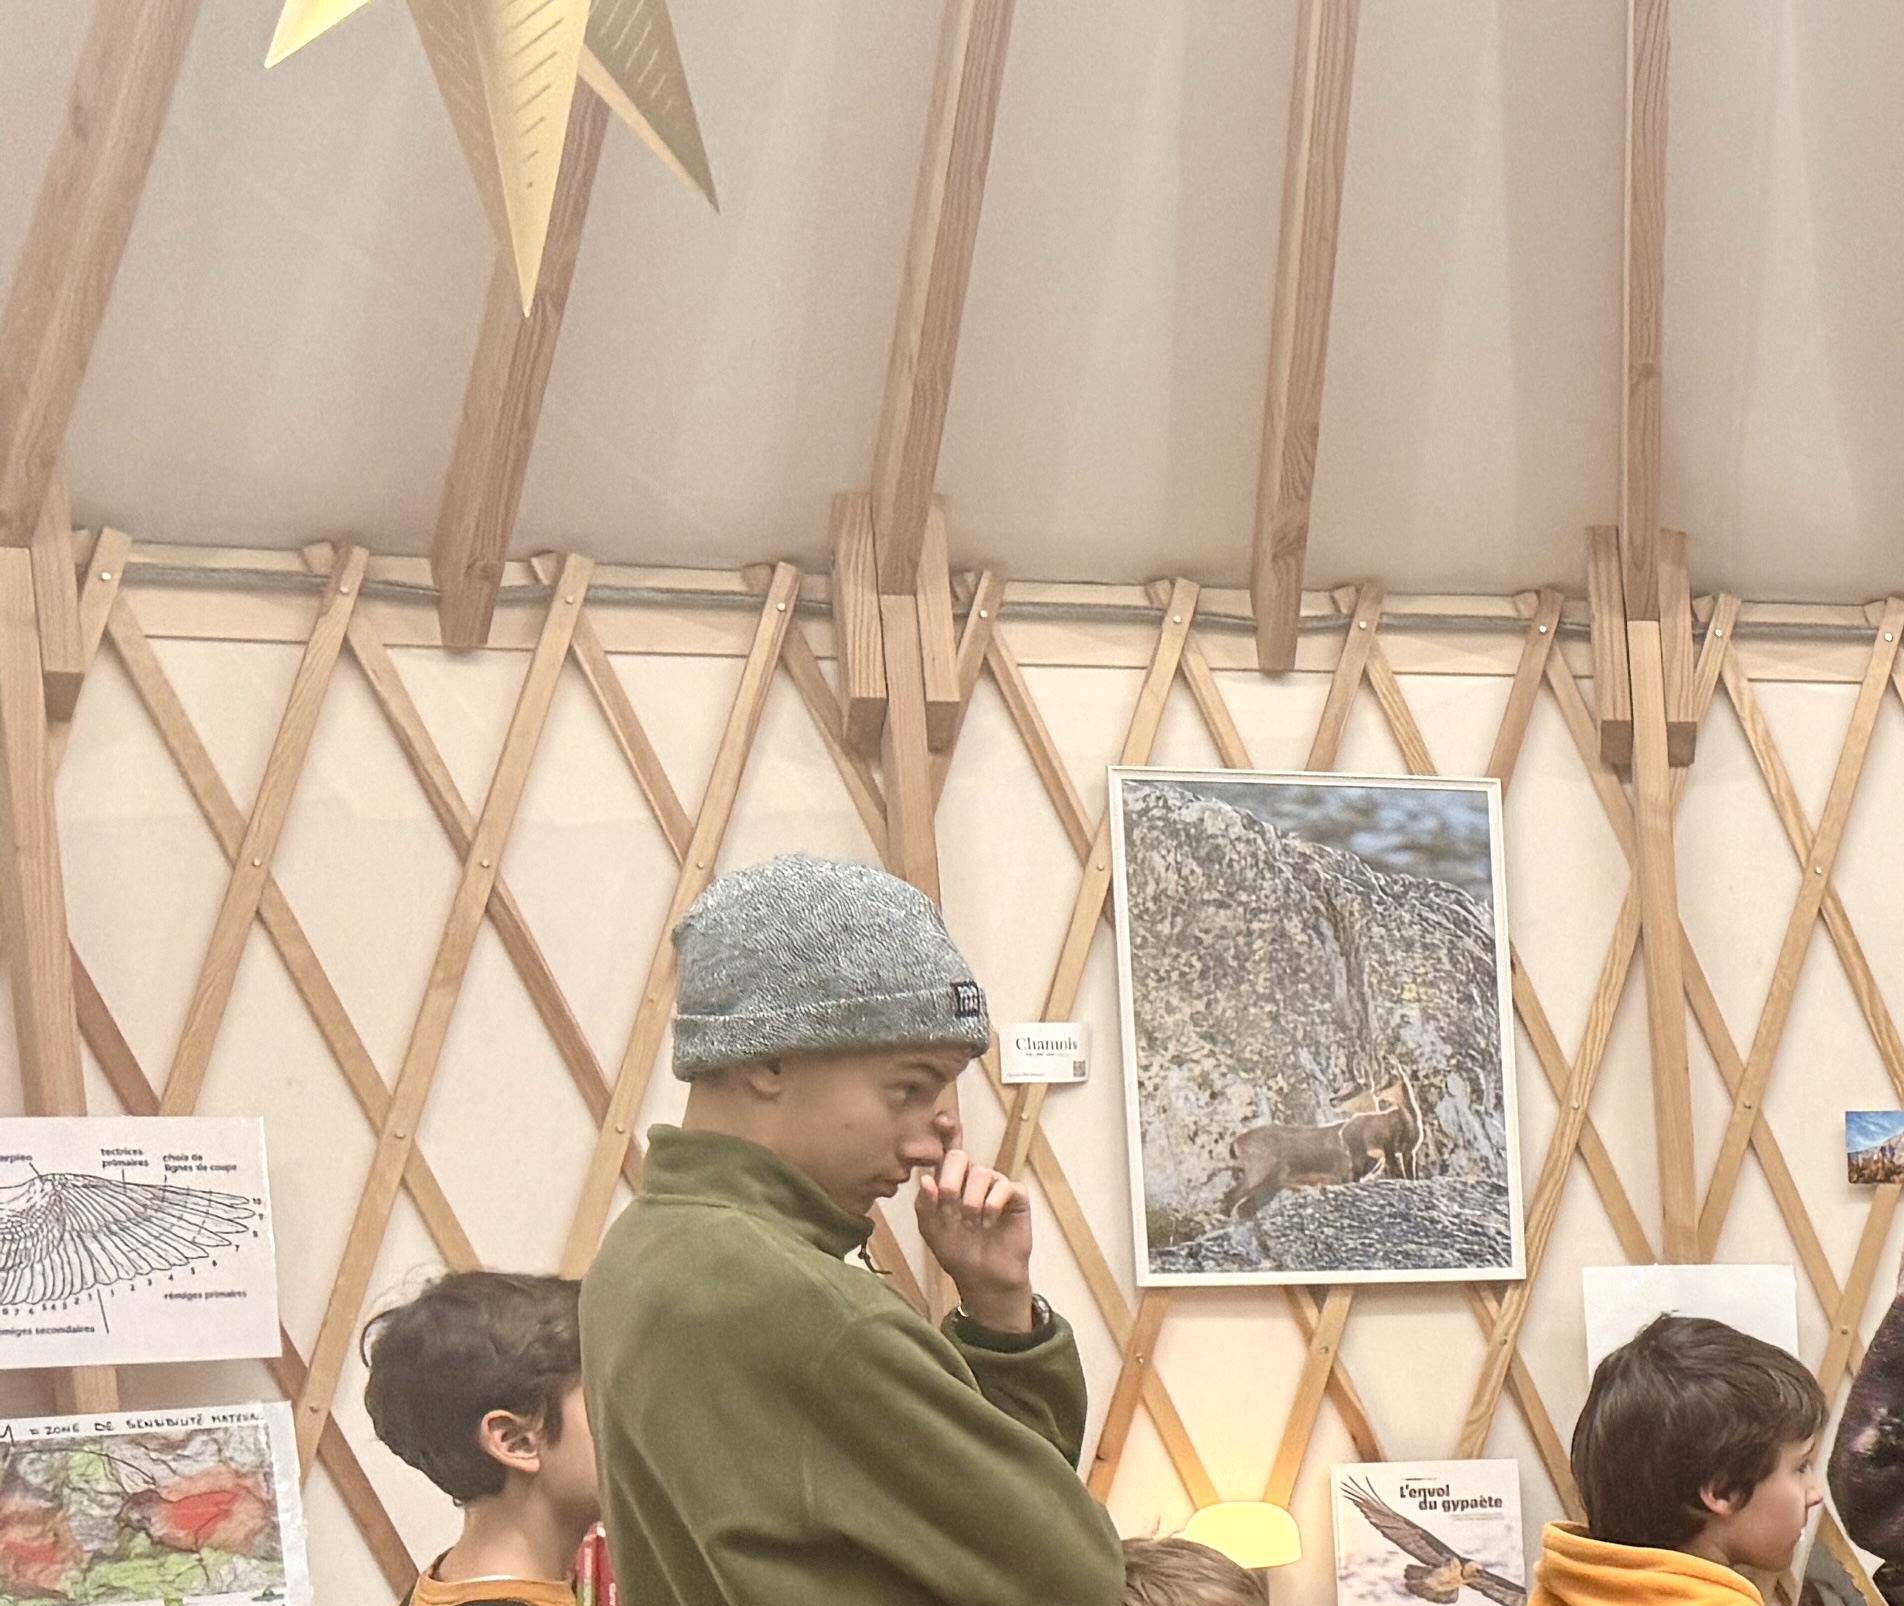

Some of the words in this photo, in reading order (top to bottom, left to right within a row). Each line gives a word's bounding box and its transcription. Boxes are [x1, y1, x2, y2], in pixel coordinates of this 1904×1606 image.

[1015, 1036, 1078, 1051] Chamois
[44, 1423, 80, 1436] ZONE
[94, 1421, 114, 1432] DE
[1399, 1483, 1451, 1502] L'envol
[1418, 1497, 1437, 1511] du
[1441, 1494, 1503, 1513] gypaète
